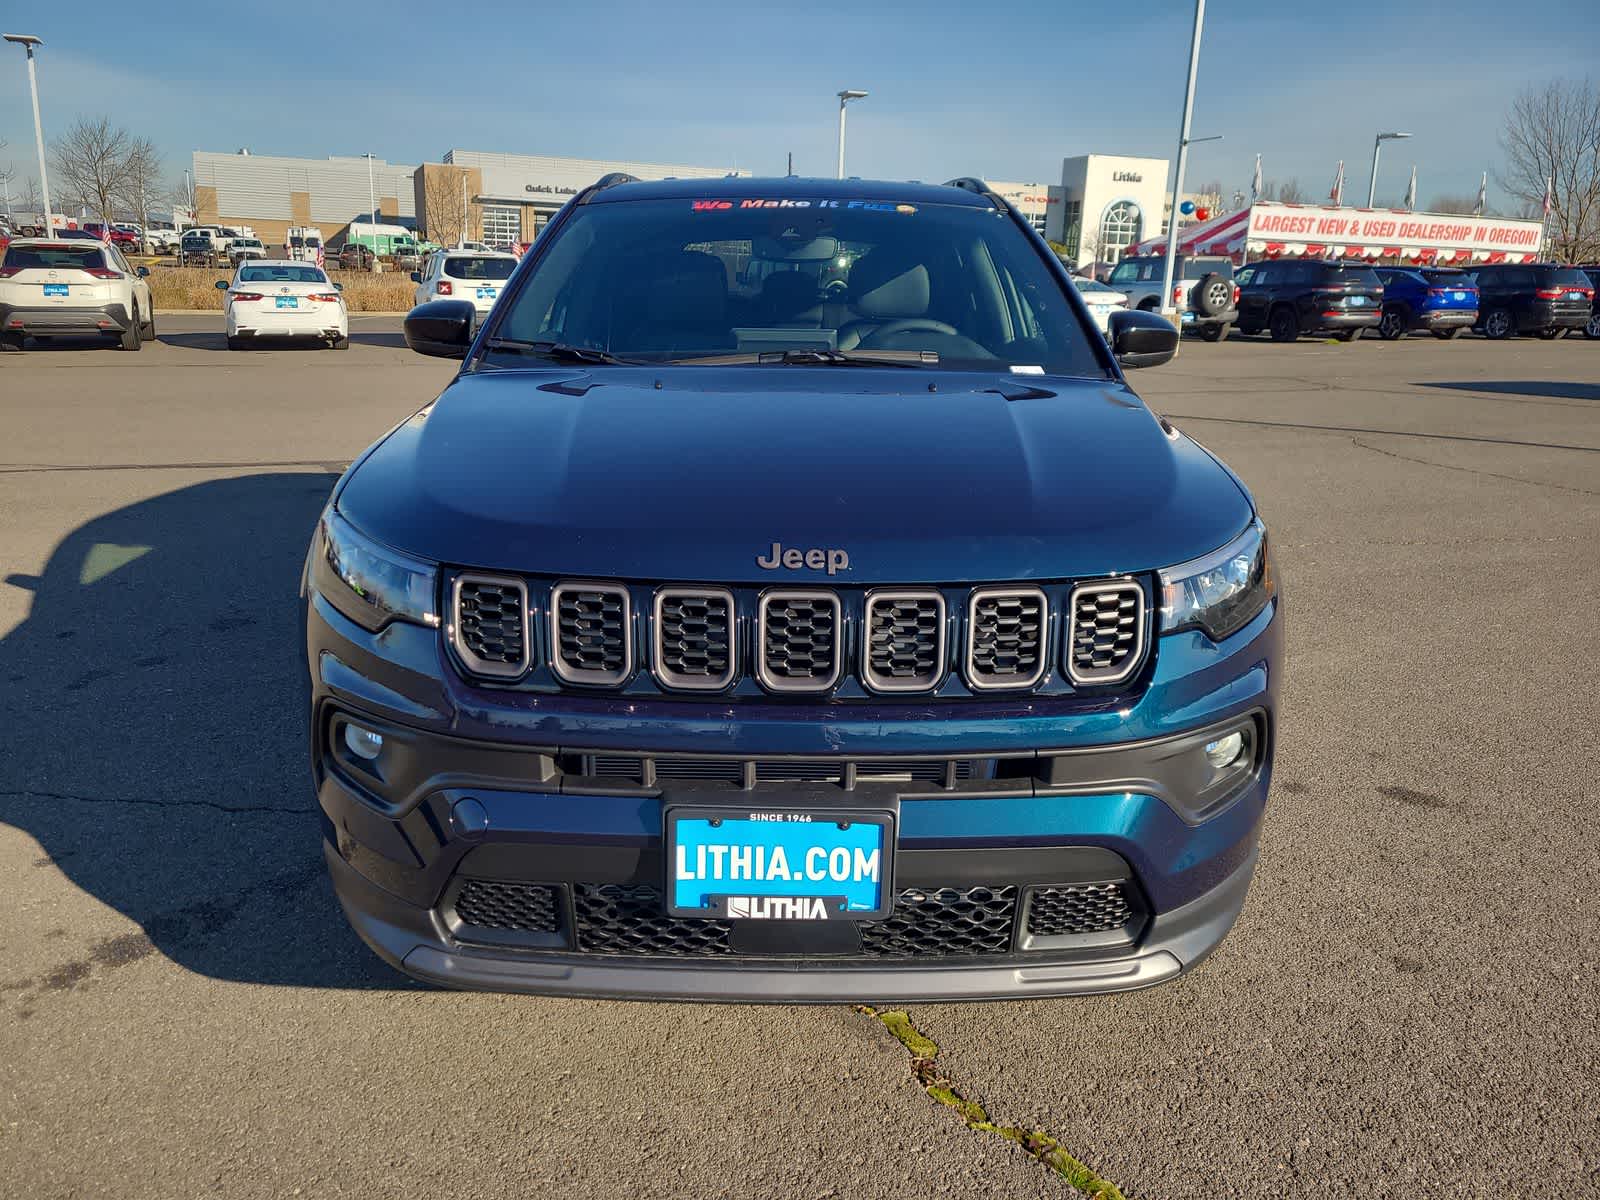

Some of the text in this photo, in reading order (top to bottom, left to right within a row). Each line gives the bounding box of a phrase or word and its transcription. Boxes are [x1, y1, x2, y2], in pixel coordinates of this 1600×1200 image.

[1112, 171, 1143, 183] Lithia
[525, 184, 552, 194] Quick
[692, 199, 733, 210] We
[740, 199, 811, 209] Make
[819, 199, 840, 209] It
[1253, 214, 1539, 246] LARGEST NEW & USED DEALERSHIP IN OREGON!
[757, 542, 849, 575] Jeep
[750, 813, 812, 823] SINCE 1946
[676, 844, 880, 883] LITHIA.COM
[750, 897, 828, 920] LITHIA
